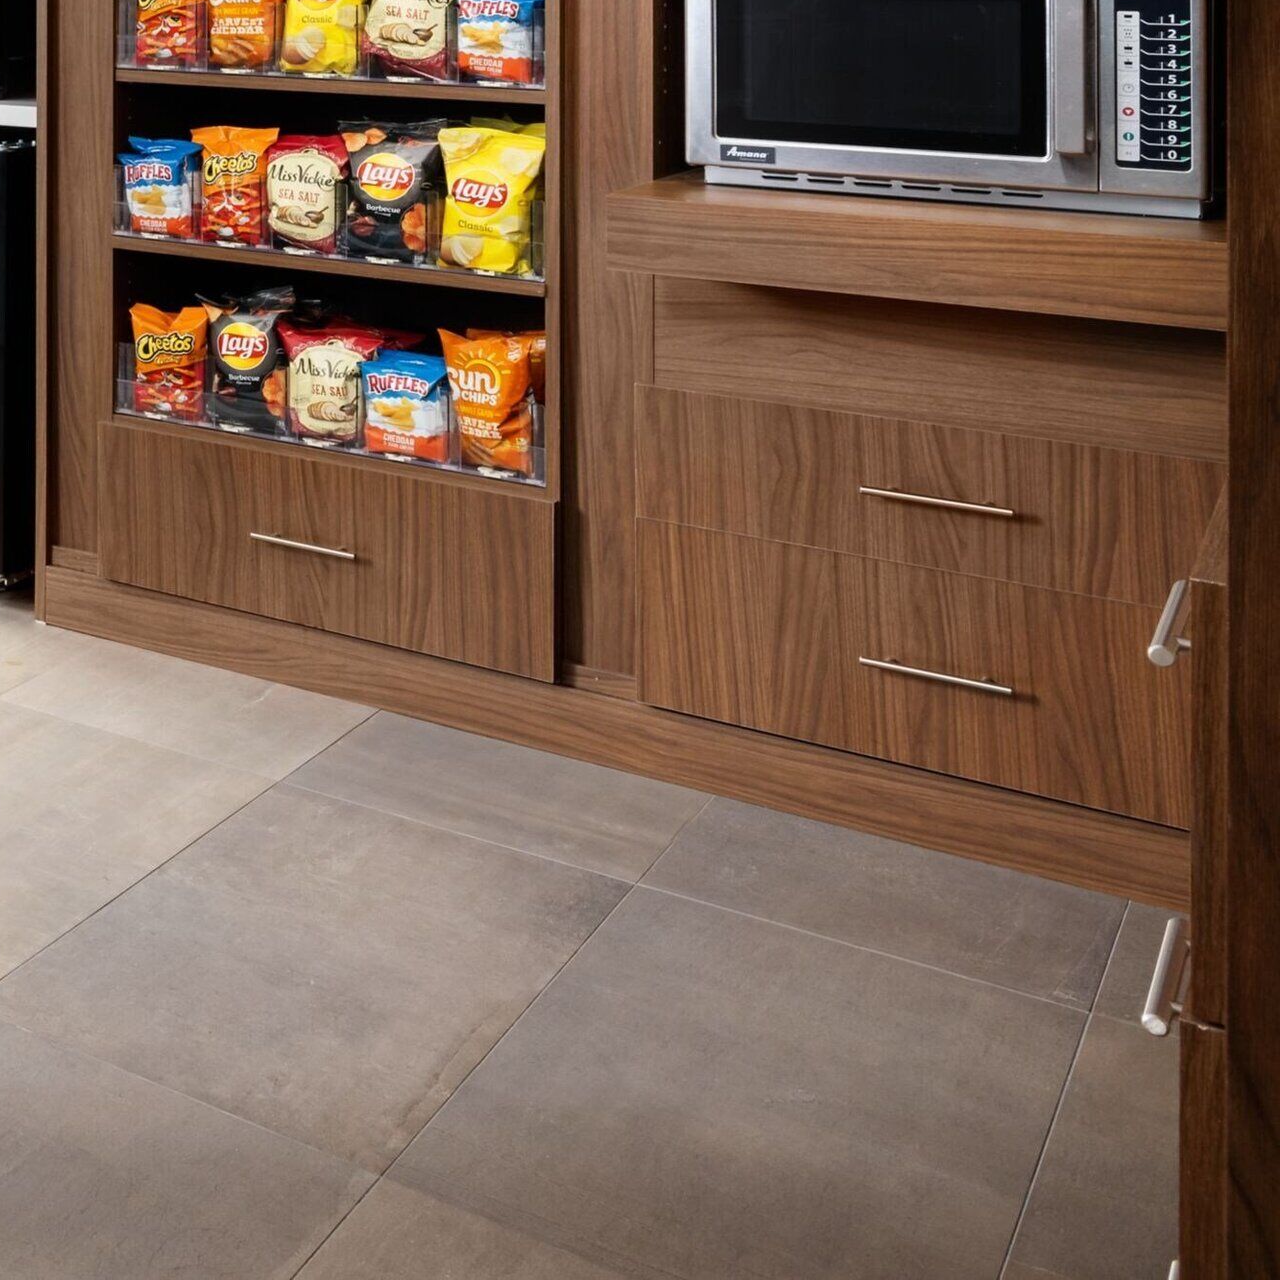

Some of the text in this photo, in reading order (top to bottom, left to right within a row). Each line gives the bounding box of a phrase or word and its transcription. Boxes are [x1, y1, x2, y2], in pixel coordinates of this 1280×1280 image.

[386, 6, 430, 20] SEA SALT
[459, 0, 518, 19] RUFFLES
[301, 15, 333, 24] Classic
[1168, 14, 1175, 23] 1
[1168, 29, 1177, 39] 2
[1168, 45, 1177, 54] 3
[469, 57, 503, 69] CHEDDAR
[1168, 60, 1177, 69] 4
[1168, 75, 1177, 84] 5
[1168, 90, 1177, 99] 6
[1168, 105, 1177, 114] 7
[1168, 120, 1177, 129] 8
[1168, 135, 1177, 144] 9
[727, 146, 767, 158] Amana
[1168, 150, 1177, 159] 0
[126, 164, 172, 183] RUFFLES
[204, 153, 257, 184] Cheetos
[269, 164, 298, 183] Miss
[361, 164, 409, 189] Lay's
[279, 188, 319, 204] SEA SALT
[455, 178, 505, 207] Lay's
[366, 204, 401, 214] Barbecue
[458, 220, 493, 233] Classic
[137, 332, 193, 362] Cheetos
[222, 334, 264, 359] Lay's
[295, 357, 327, 378] Miss
[229, 374, 260, 383] Barbecue
[368, 374, 428, 395] RUFFLES
[311, 384, 326, 396] SEA
[461, 392, 497, 406] CHIPS
